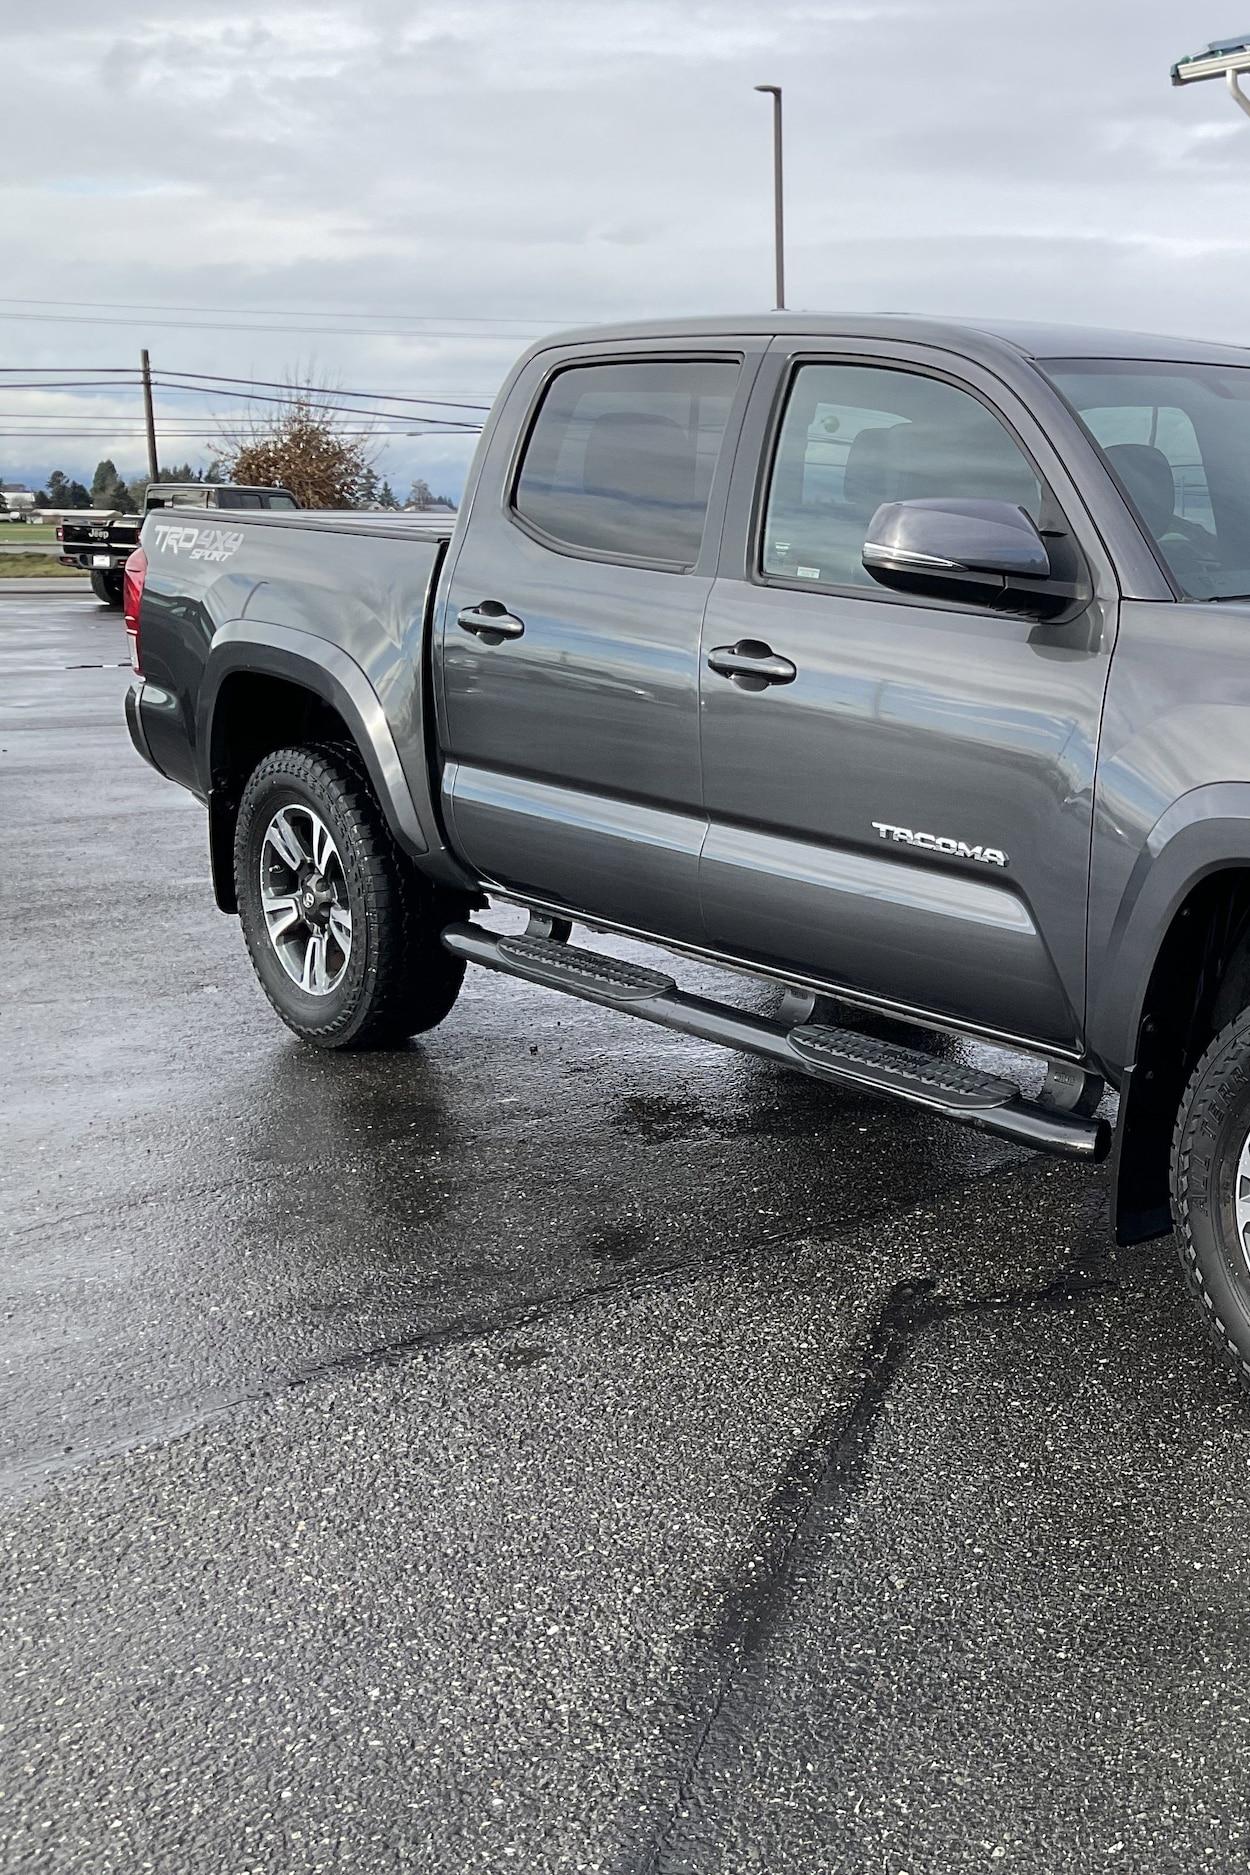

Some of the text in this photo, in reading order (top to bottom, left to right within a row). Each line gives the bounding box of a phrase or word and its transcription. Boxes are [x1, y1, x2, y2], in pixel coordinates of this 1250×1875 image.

[88, 528, 109, 539] Jeep
[154, 525, 199, 554] TRD
[189, 548, 234, 561] SPORT
[871, 821, 1009, 867] TACOMA
[1191, 1154, 1211, 1218] ALL
